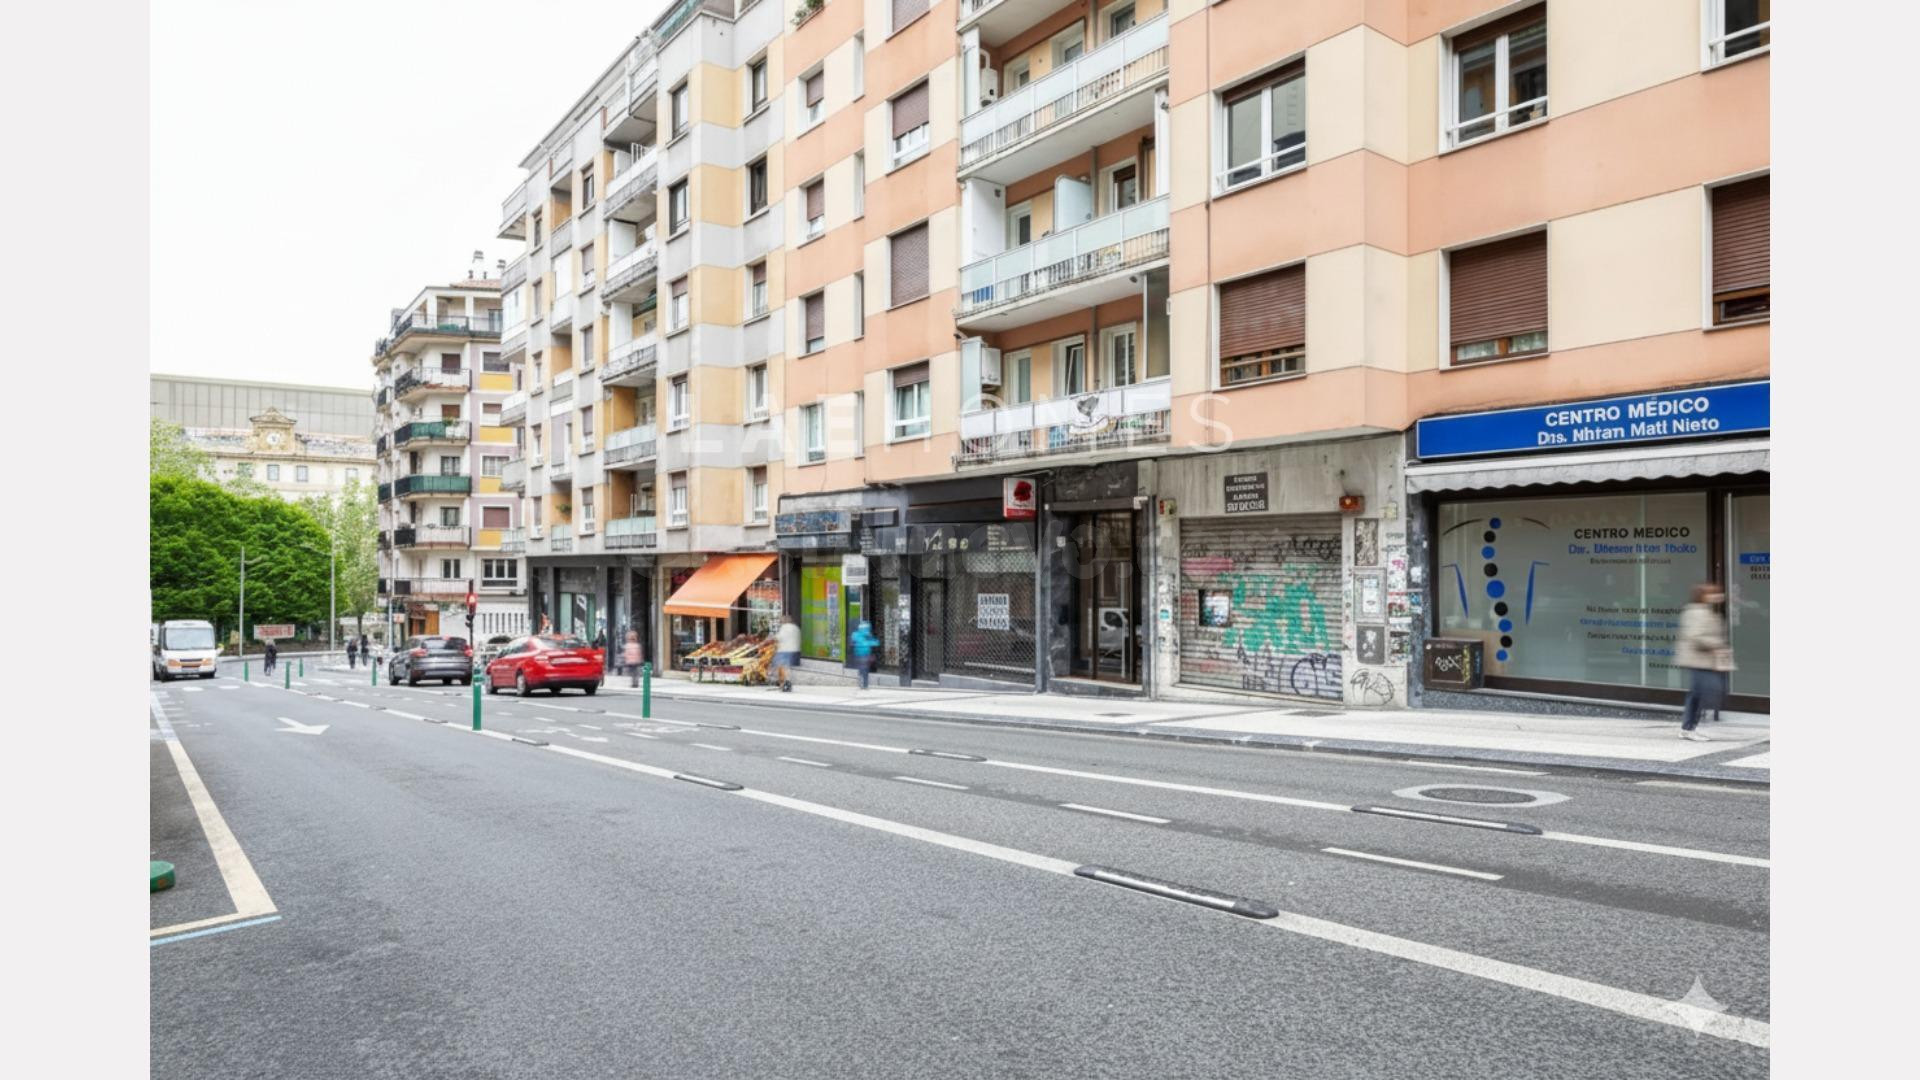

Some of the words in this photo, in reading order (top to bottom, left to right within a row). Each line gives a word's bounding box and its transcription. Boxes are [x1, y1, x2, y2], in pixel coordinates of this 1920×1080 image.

[1546, 406, 1620, 427] CENTRO
[1628, 396, 1710, 420] MÉDICO
[1672, 417, 1720, 434] Nieto
[1574, 528, 1629, 540] CENTRO
[1633, 526, 1691, 539] MEDICO
